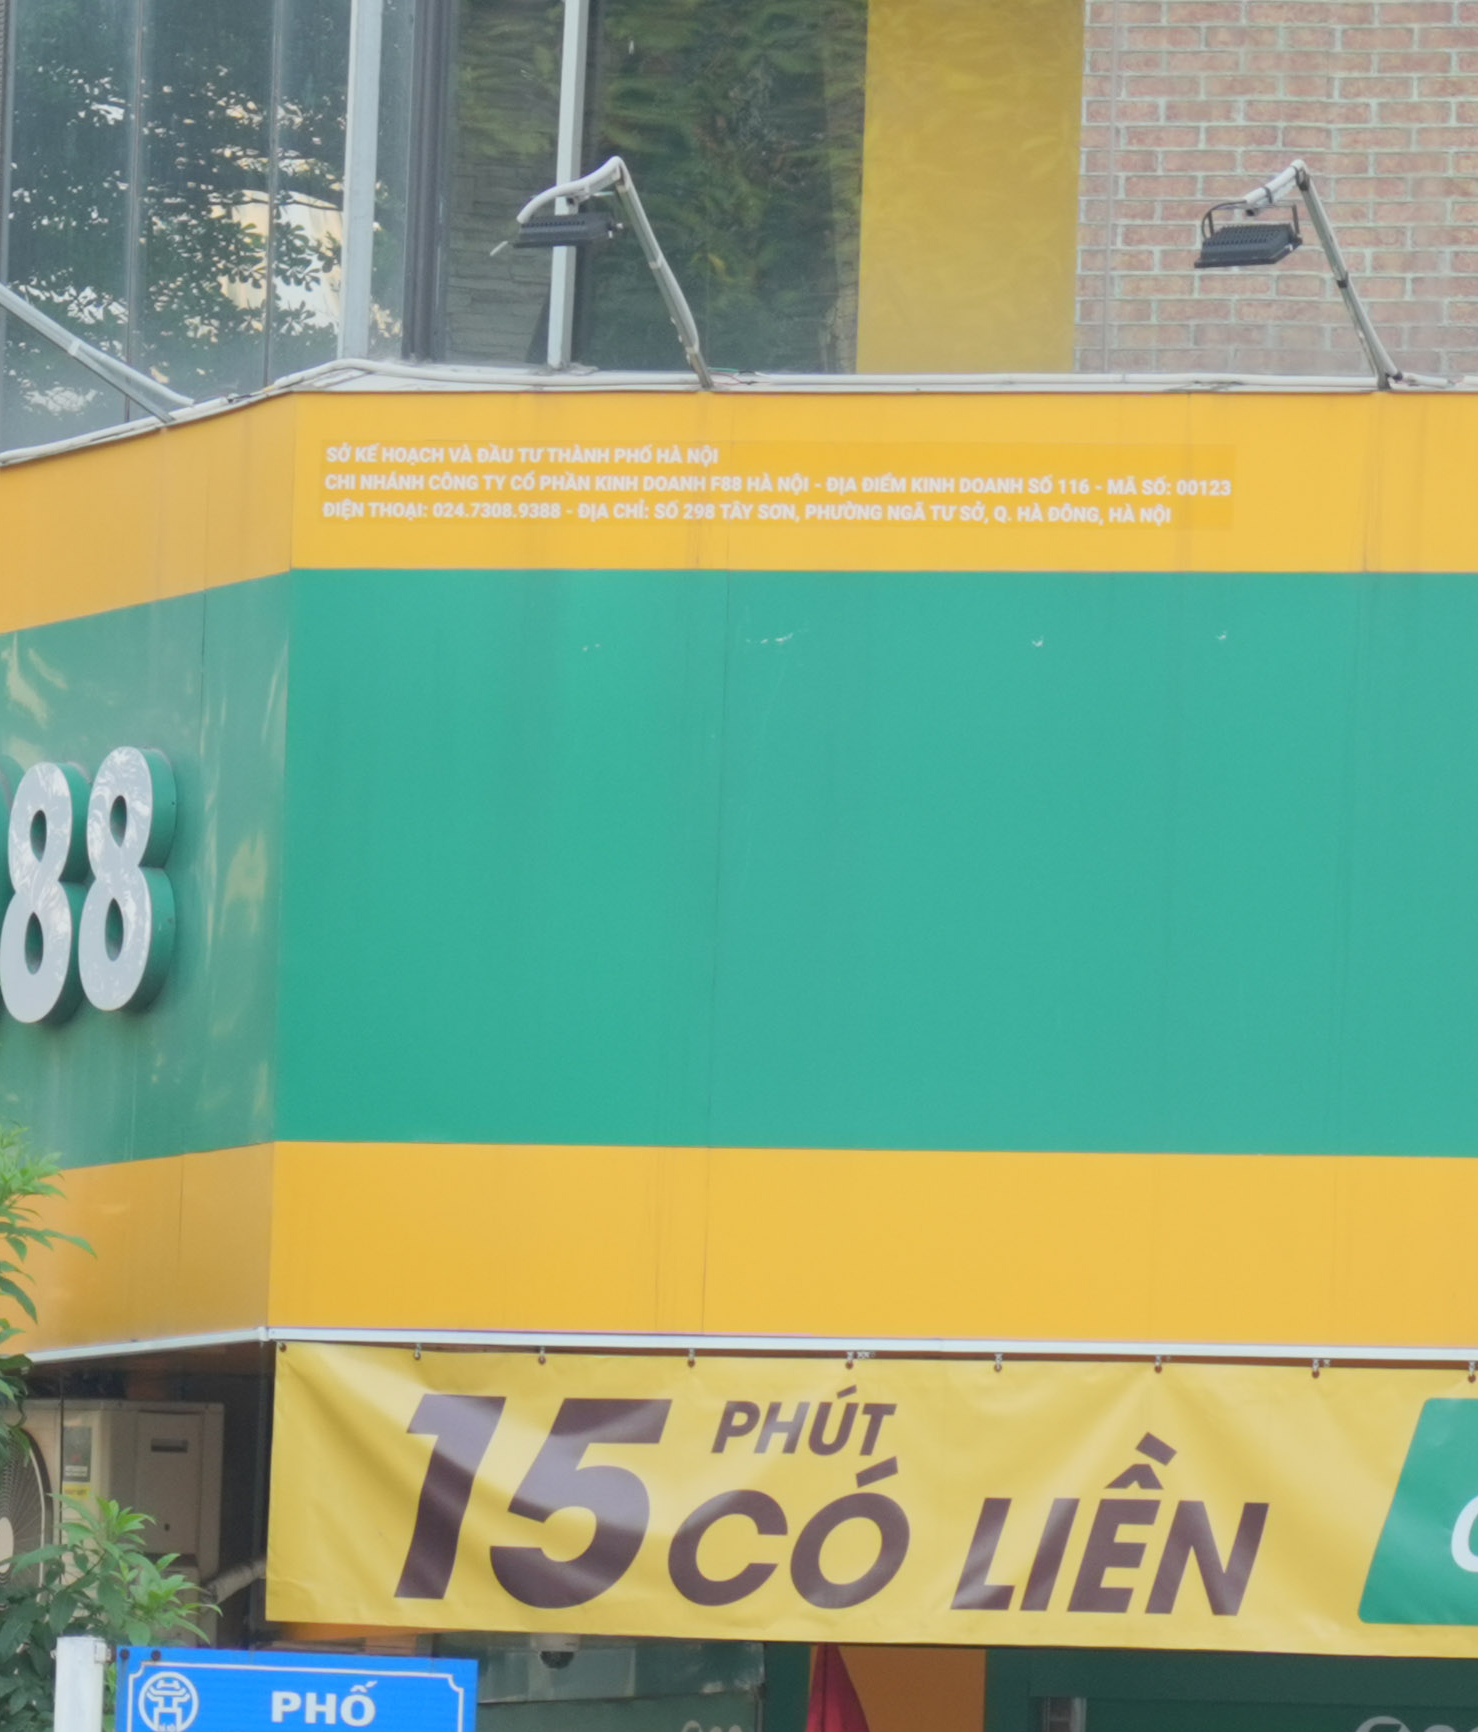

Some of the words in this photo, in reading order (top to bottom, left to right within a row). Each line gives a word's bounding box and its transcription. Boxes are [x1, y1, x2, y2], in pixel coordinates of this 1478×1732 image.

[325, 441, 353, 463] SỞ
[354, 442, 381, 463] KẾ
[381, 445, 446, 466] HOẠCH
[447, 443, 474, 463] VÀ
[476, 443, 515, 464] ĐẦU
[517, 443, 546, 463] TƯ
[546, 443, 612, 463] THÀNH
[613, 443, 654, 464] PHỐ
[655, 444, 684, 464] HÀ
[686, 444, 720, 468] NỘI
[323, 473, 357, 490] CHI
[359, 471, 424, 491] NHÁNH
[427, 471, 481, 491] CÔNG
[482, 473, 507, 491] TY
[538, 470, 593, 492] PHẦN
[594, 474, 641, 492] KINH
[642, 475, 707, 492] DOANH
[709, 475, 743, 492] F88
[745, 472, 774, 492] HÀ
[777, 472, 811, 495] NỘI
[825, 476, 859, 495] ĐỊA
[910, 476, 956, 493] KINH
[958, 476, 1025, 494] DOANH
[1027, 475, 1055, 494] SỐ
[1059, 478, 1091, 495] 116
[1106, 475, 1139, 495] MÃ
[1141, 476, 1172, 496] SỐ:
[1175, 479, 1232, 497] 00123
[321, 497, 365, 521] ĐIỆN
[367, 501, 430, 521] THOẠI:
[432, 501, 563, 519] 024.7308.9388
[577, 501, 611, 522] ĐỊA
[612, 498, 651, 519] CHỈ:
[653, 500, 681, 520] SỐ
[682, 502, 717, 521] 298
[719, 500, 754, 521] TÂY
[757, 502, 801, 522] SƠN,
[804, 500, 885, 521] PHƯỜNG
[886, 500, 927, 521] NGÃ
[929, 500, 957, 521] TƯ
[958, 500, 990, 524] SỞ,
[992, 505, 1012, 523] Q.
[1016, 502, 1045, 523] HÀ
[1108, 503, 1137, 523] HÀ
[1139, 503, 1173, 527] NỘI
[711, 1385, 896, 1456] PHÚT
[394, 1393, 672, 1609] 15
[667, 1457, 911, 1608] CÓ
[950, 1431, 1269, 1616] LIỀN
[270, 1681, 376, 1727] PHỐ
